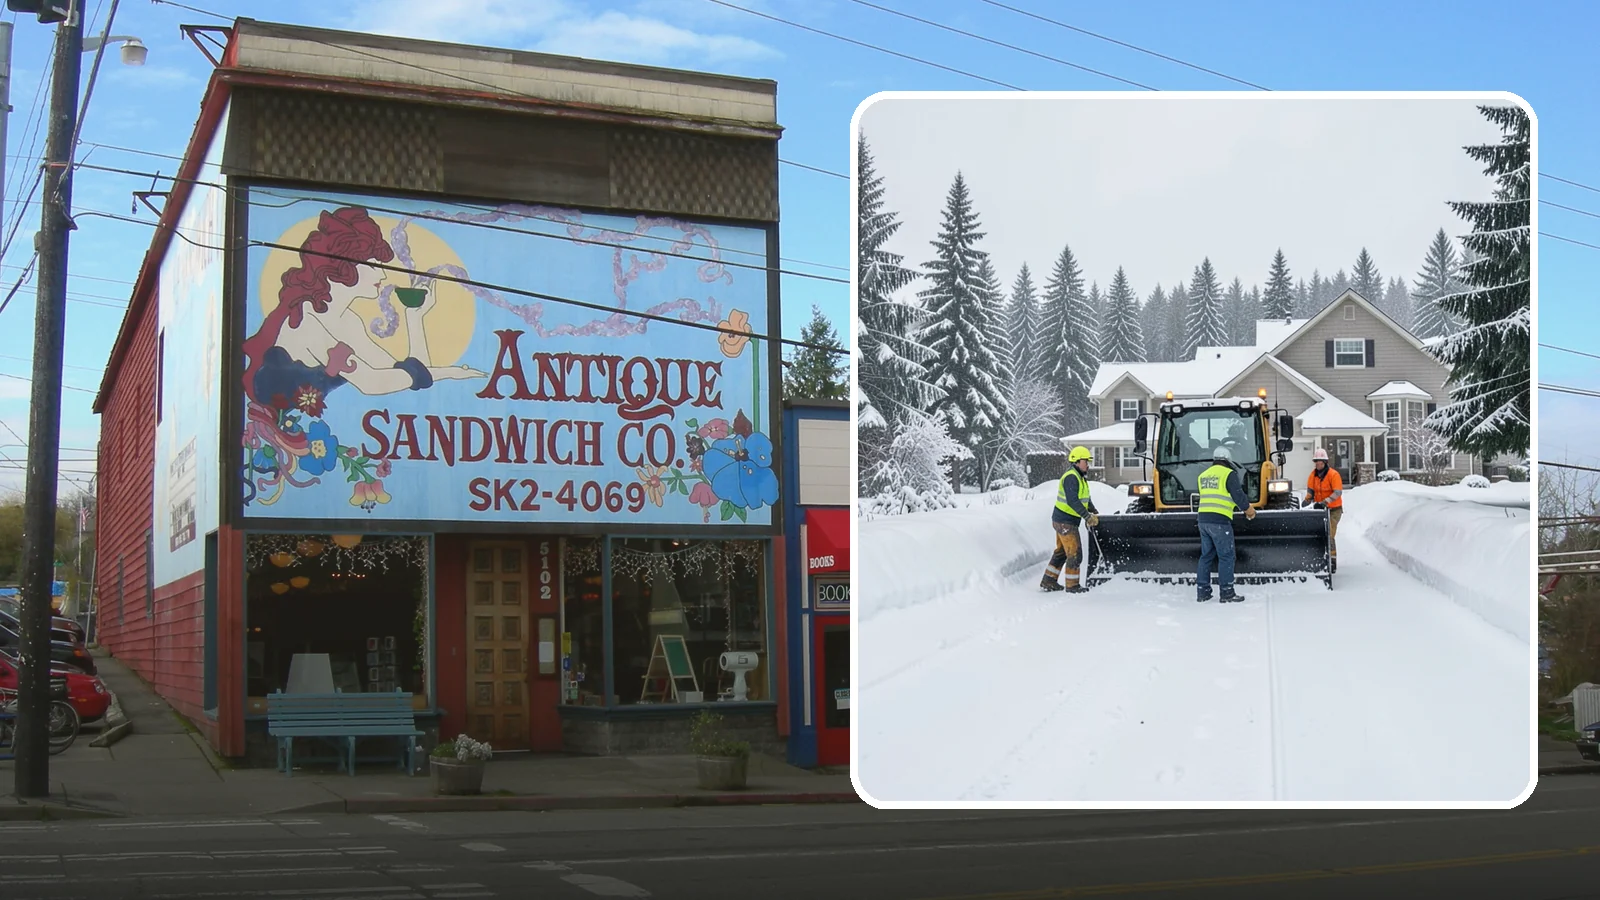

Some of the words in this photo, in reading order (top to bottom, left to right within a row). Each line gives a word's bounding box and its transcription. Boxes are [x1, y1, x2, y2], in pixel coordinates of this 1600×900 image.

[476, 329, 724, 421] ANTIQUE
[361, 408, 605, 468] SANDWICH
[617, 421, 685, 469] CO.
[467, 476, 646, 513] SK2-4069
[539, 541, 552, 600] 5102
[809, 555, 835, 569] BOOKS
